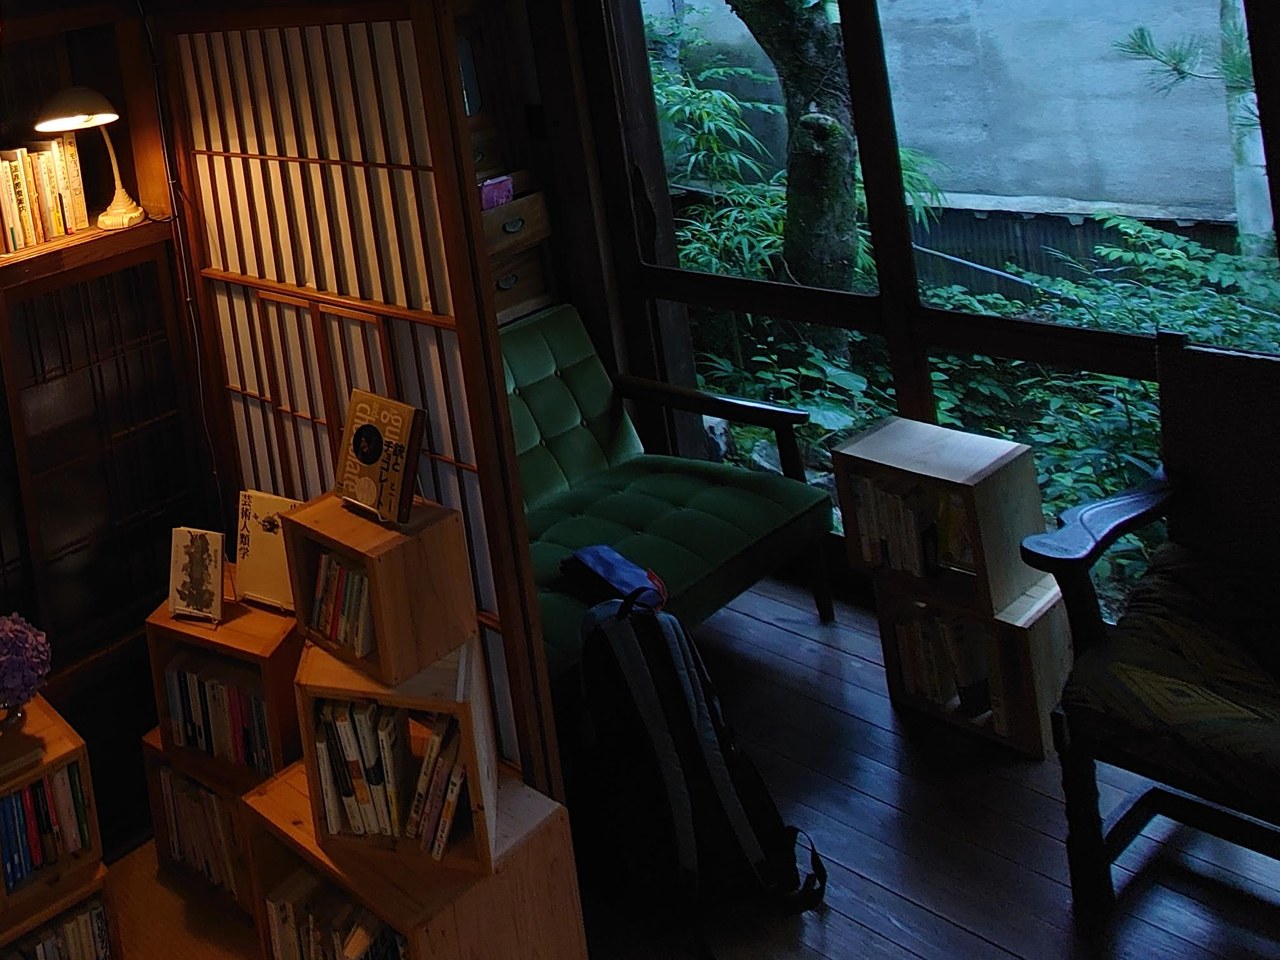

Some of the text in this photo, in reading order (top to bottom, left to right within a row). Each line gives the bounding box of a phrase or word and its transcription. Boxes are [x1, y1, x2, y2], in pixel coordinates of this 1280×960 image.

[342, 402, 377, 493] chlate
[376, 440, 394, 510] チョコレート
[239, 494, 253, 560] 芸術人類学
